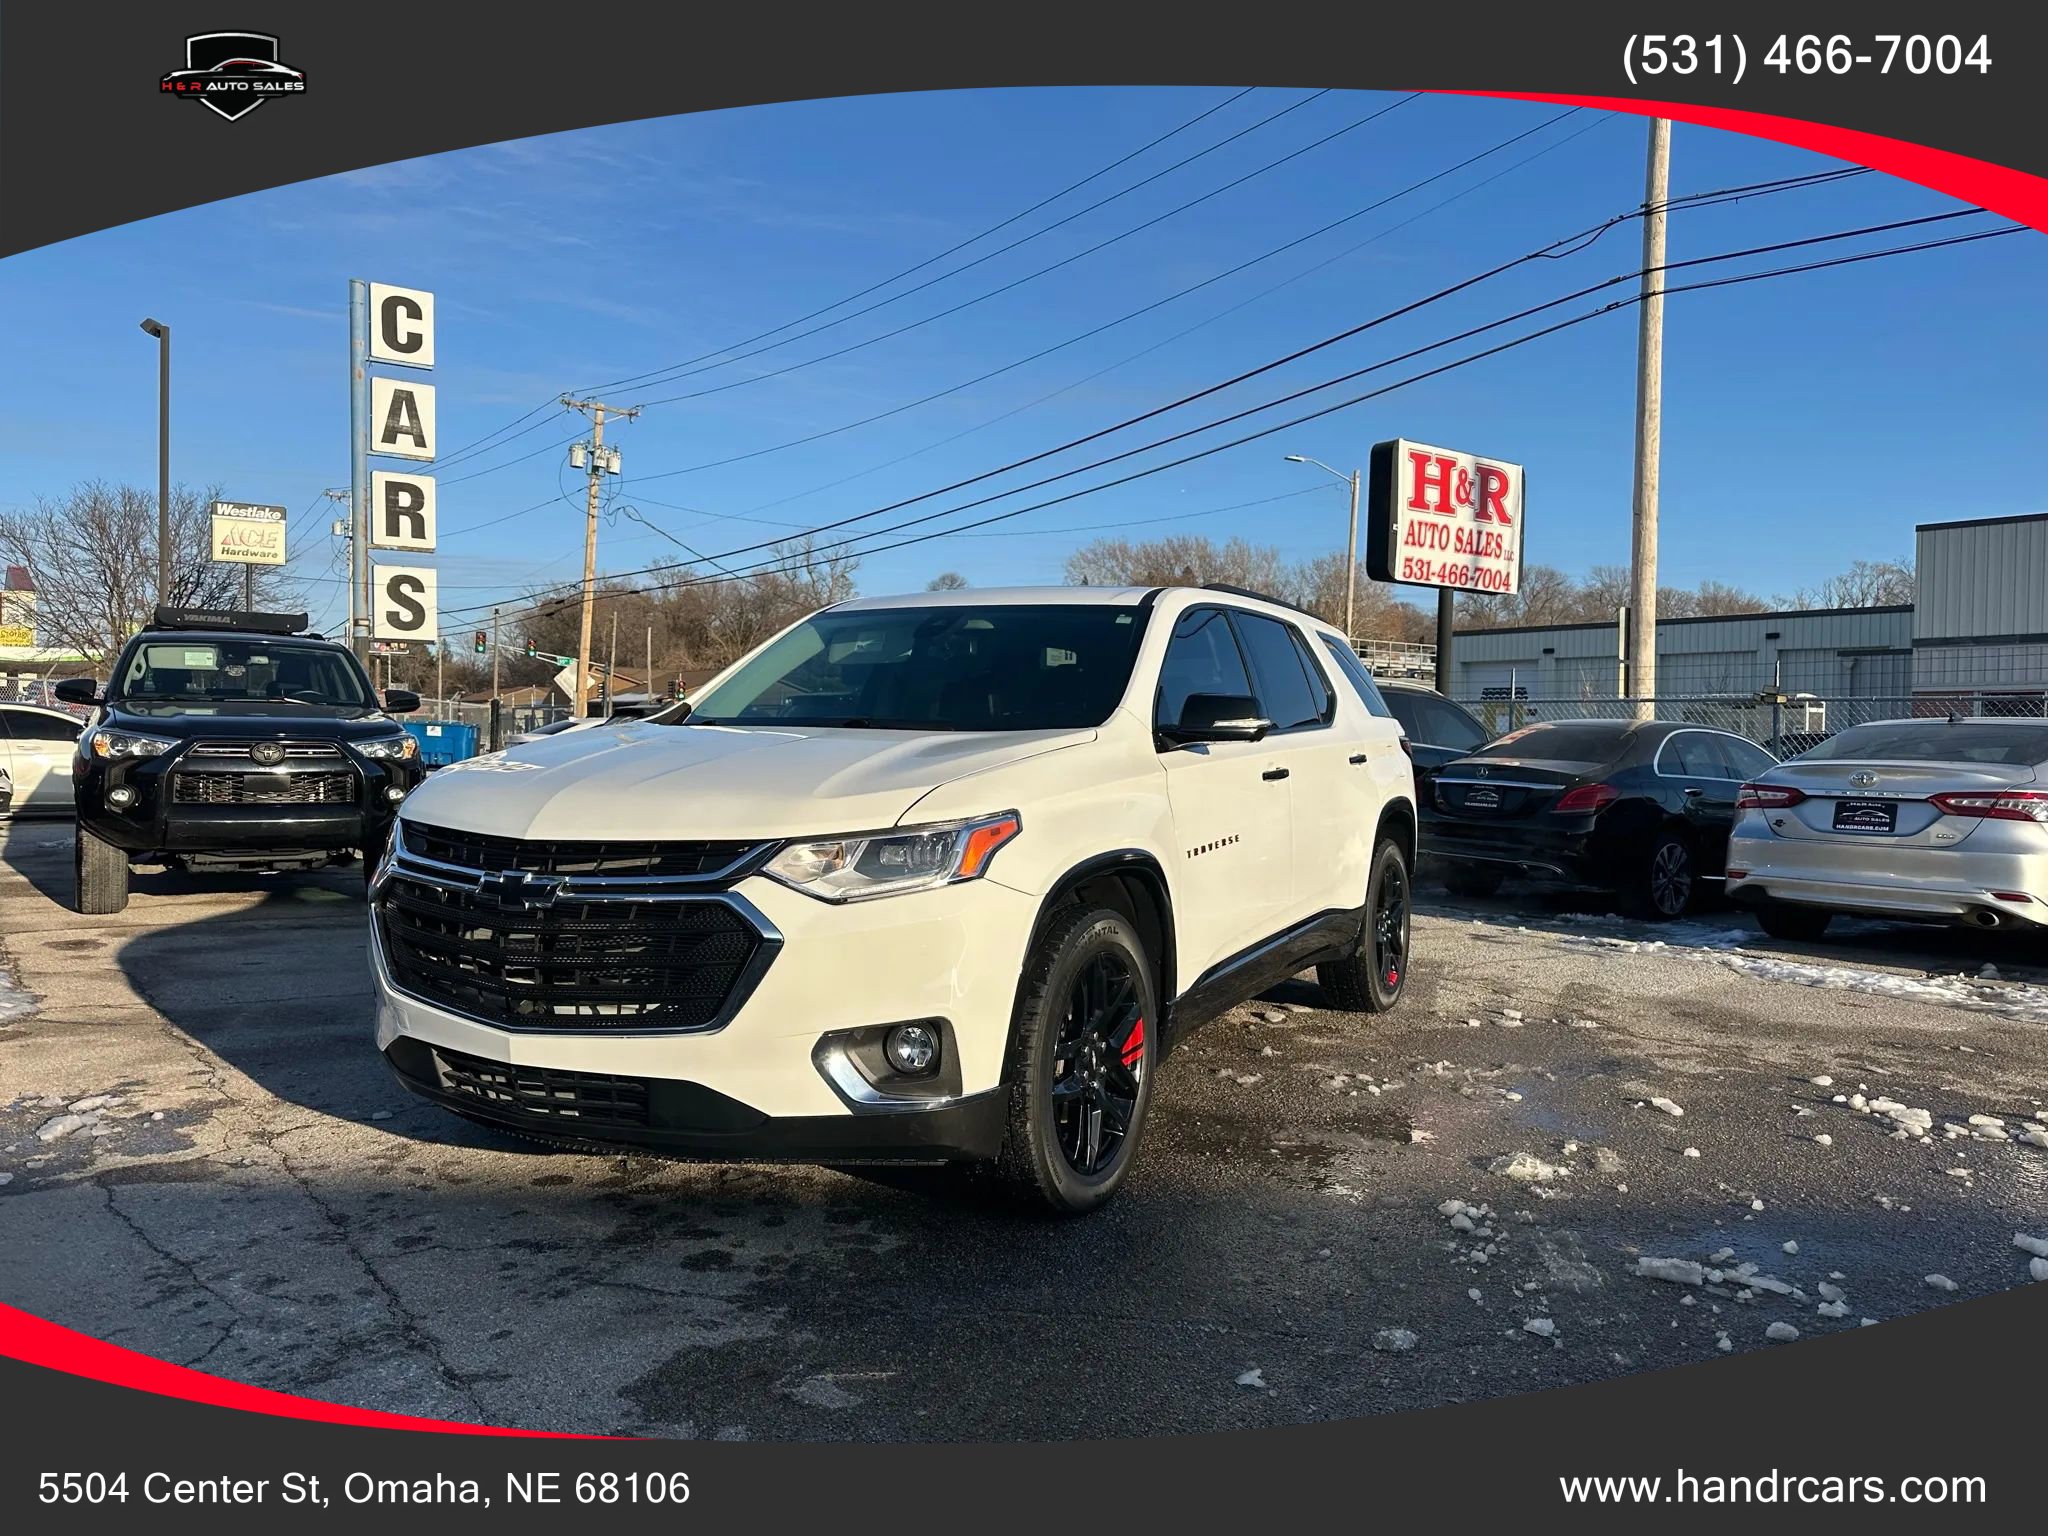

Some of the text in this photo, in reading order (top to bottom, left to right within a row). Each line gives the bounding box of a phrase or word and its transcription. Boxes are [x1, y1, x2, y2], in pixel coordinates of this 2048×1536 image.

[1408, 449, 1513, 528] H&R
[216, 503, 282, 520] Westlake
[221, 524, 279, 548] ACE
[1404, 519, 1515, 562] AUTO SALES LLC
[221, 546, 279, 559] Hardware
[1403, 556, 1512, 592] 531-466-7004
[184, 614, 231, 624] YAKIMA
[1186, 834, 1240, 859] TRAVERSE
